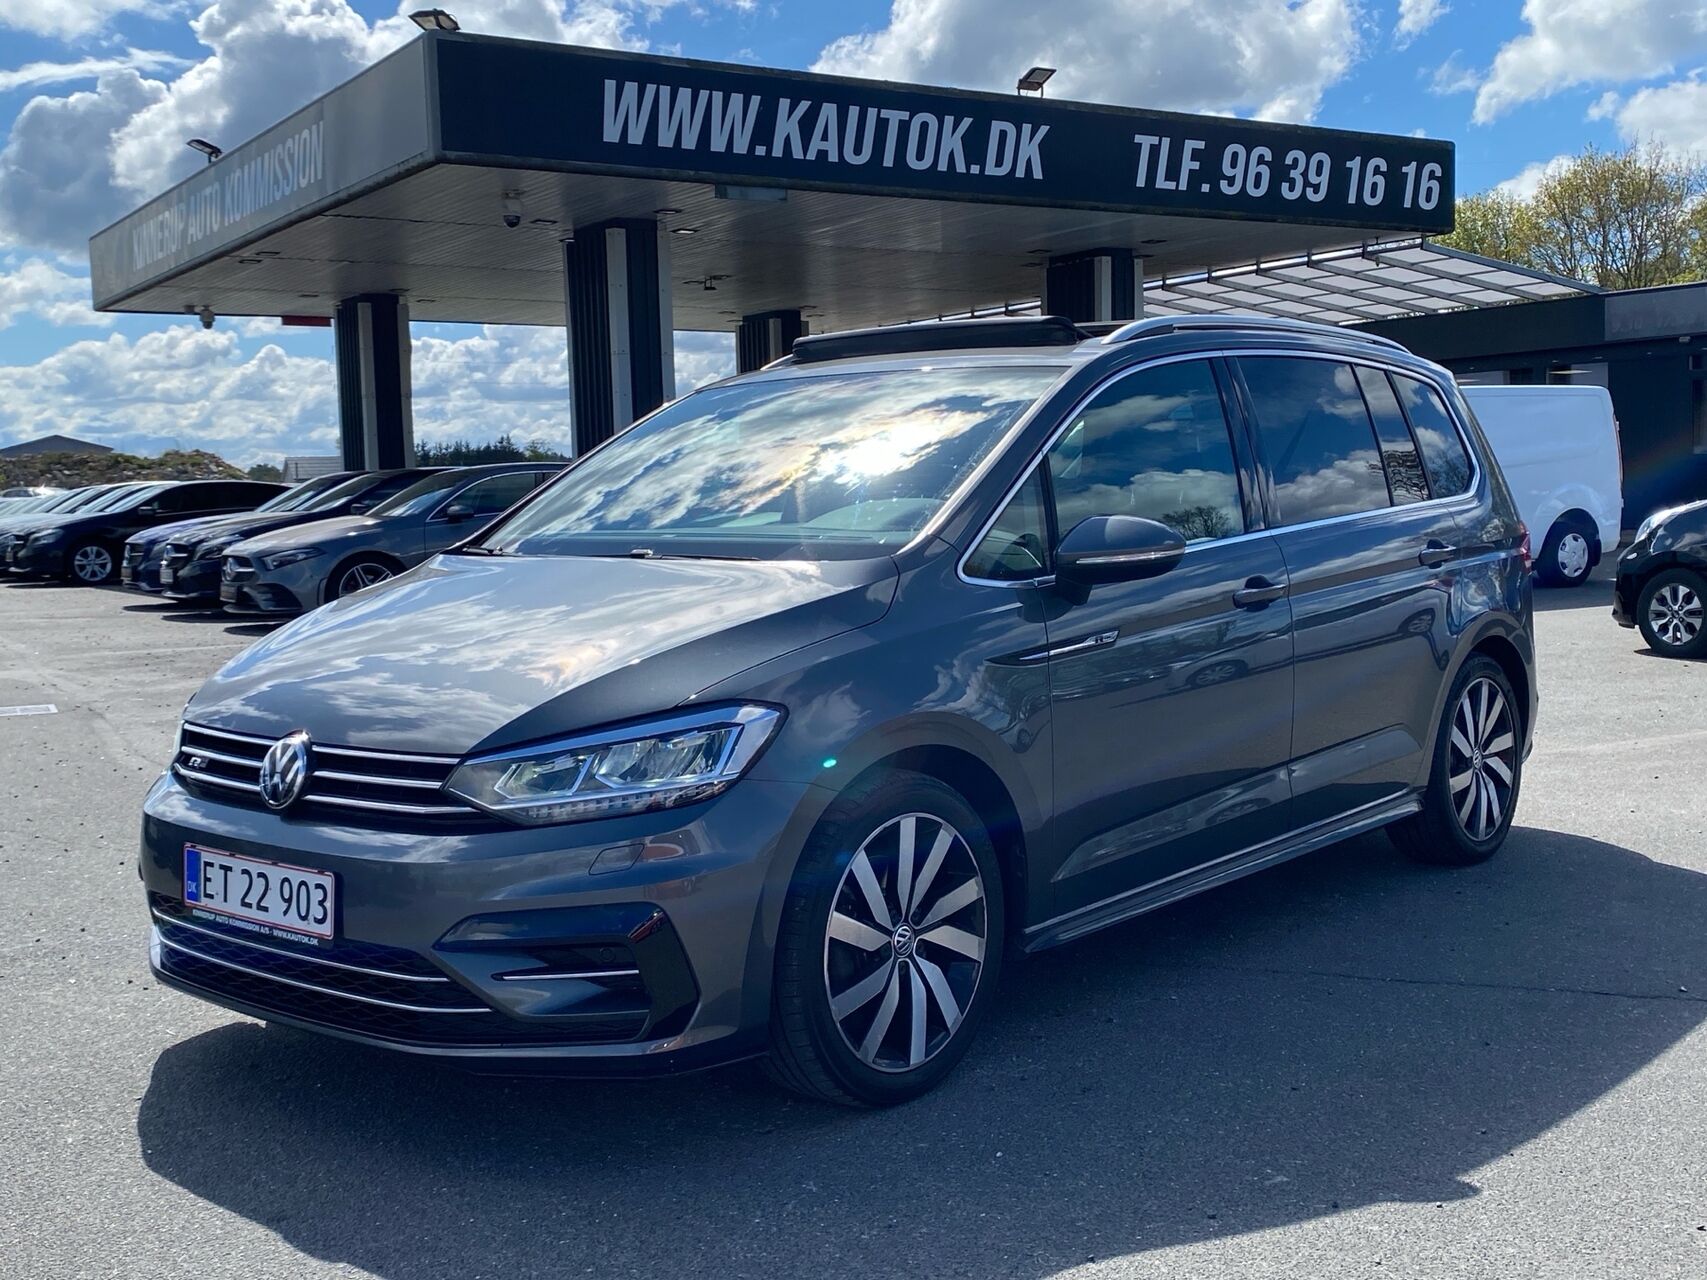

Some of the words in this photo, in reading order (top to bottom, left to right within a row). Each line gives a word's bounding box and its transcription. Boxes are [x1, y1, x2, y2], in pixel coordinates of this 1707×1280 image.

[603, 79, 1050, 180] WWW.KAUTOK.DK
[1134, 134, 1210, 193] TLF.
[1219, 143, 1273, 198] 96
[1281, 149, 1331, 202] 39
[1345, 156, 1387, 206] 16
[1401, 161, 1442, 211] 16
[187, 182, 220, 244] AUTO
[224, 121, 324, 226] KOMMISSION
[203, 860, 233, 903] ET
[240, 868, 269, 913] 22
[279, 876, 328, 925] 903
